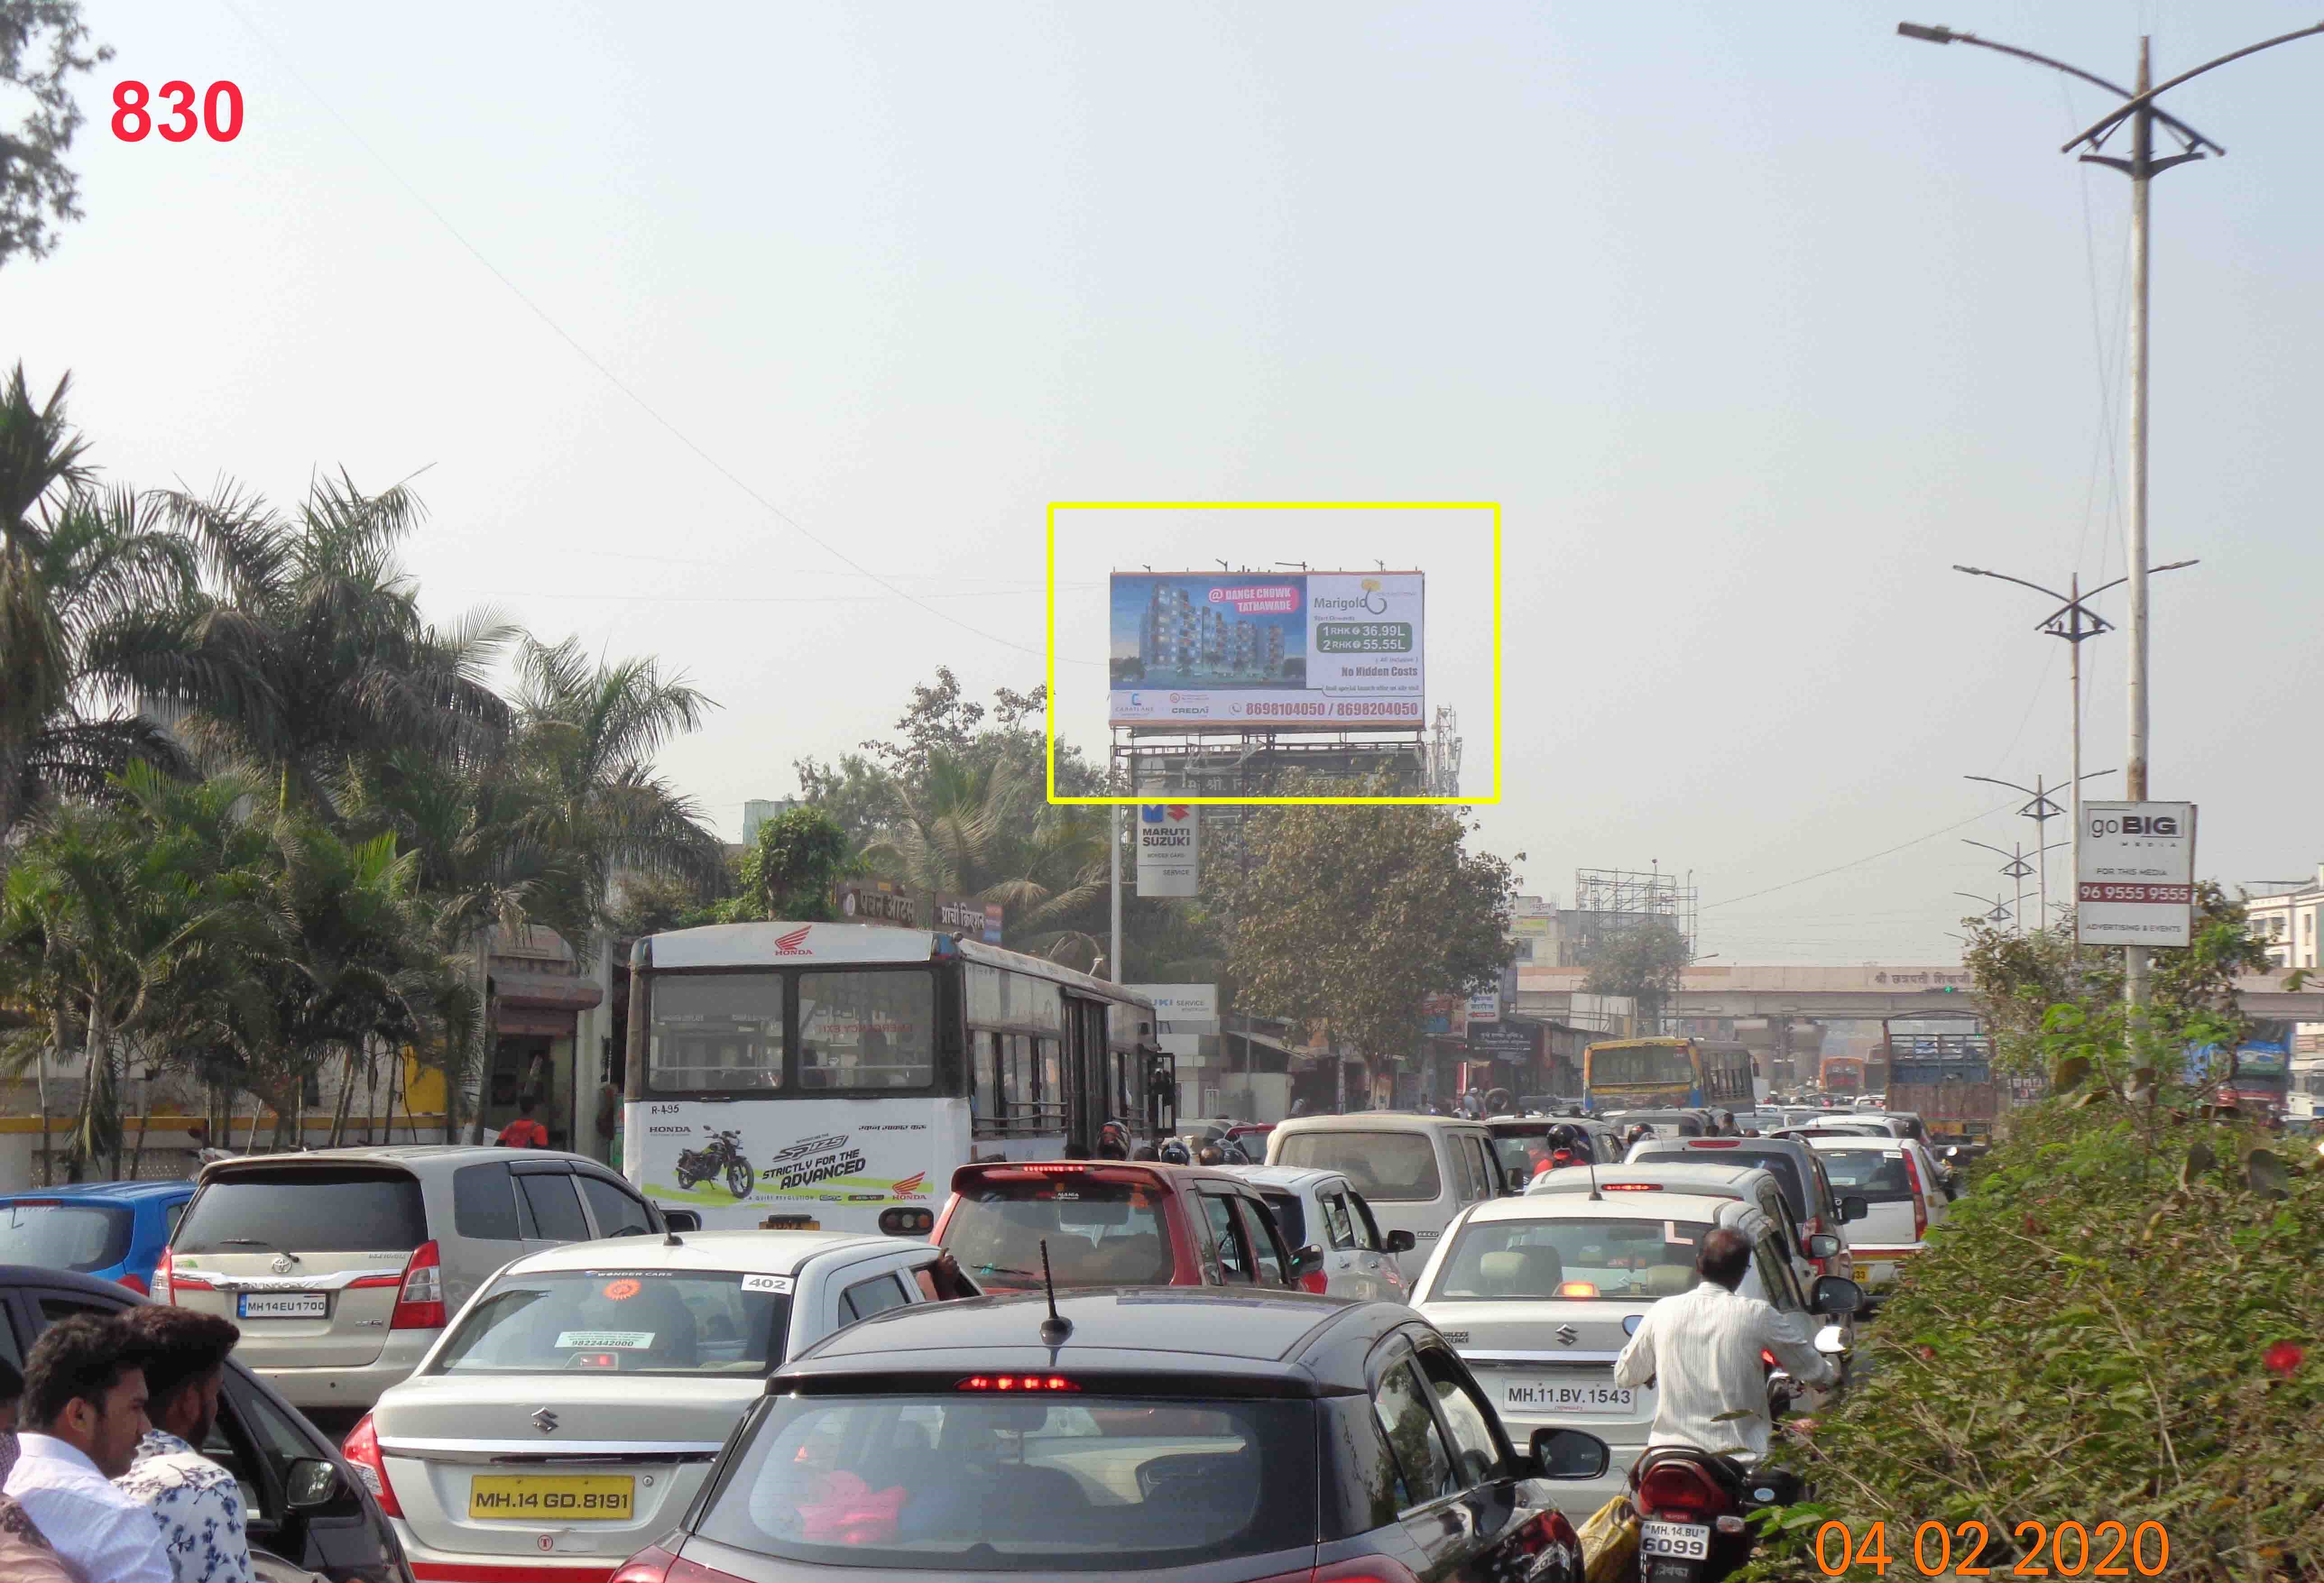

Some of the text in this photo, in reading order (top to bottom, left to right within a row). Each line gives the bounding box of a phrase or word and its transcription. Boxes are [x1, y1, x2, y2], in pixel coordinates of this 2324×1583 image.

[1208, 588, 1291, 603] @ DANGE CHOWK
[1314, 597, 1367, 611] Marigold
[1362, 625, 1406, 636] 36.99L
[1363, 640, 1406, 650] 55.55L
[1342, 666, 1418, 676] No Hidden Costs
[1246, 703, 1325, 715] 8698104050
[1337, 702, 1418, 715] 8698204050
[1142, 836, 1190, 847] SUZUKI
[2081, 886, 2188, 900] 96 9555 9555
[652, 1104, 679, 1114] R-495
[762, 1148, 860, 1180] STRICTLY FOR THE
[779, 1157, 866, 1190] ADVANCED
[1664, 1221, 1693, 1245] L
[747, 1278, 787, 1290] 402
[1508, 1388, 1631, 1404] MH.11.BV.1543
[475, 1492, 628, 1509] MH.14 GD.8191
[1642, 1537, 1704, 1555] 6099
